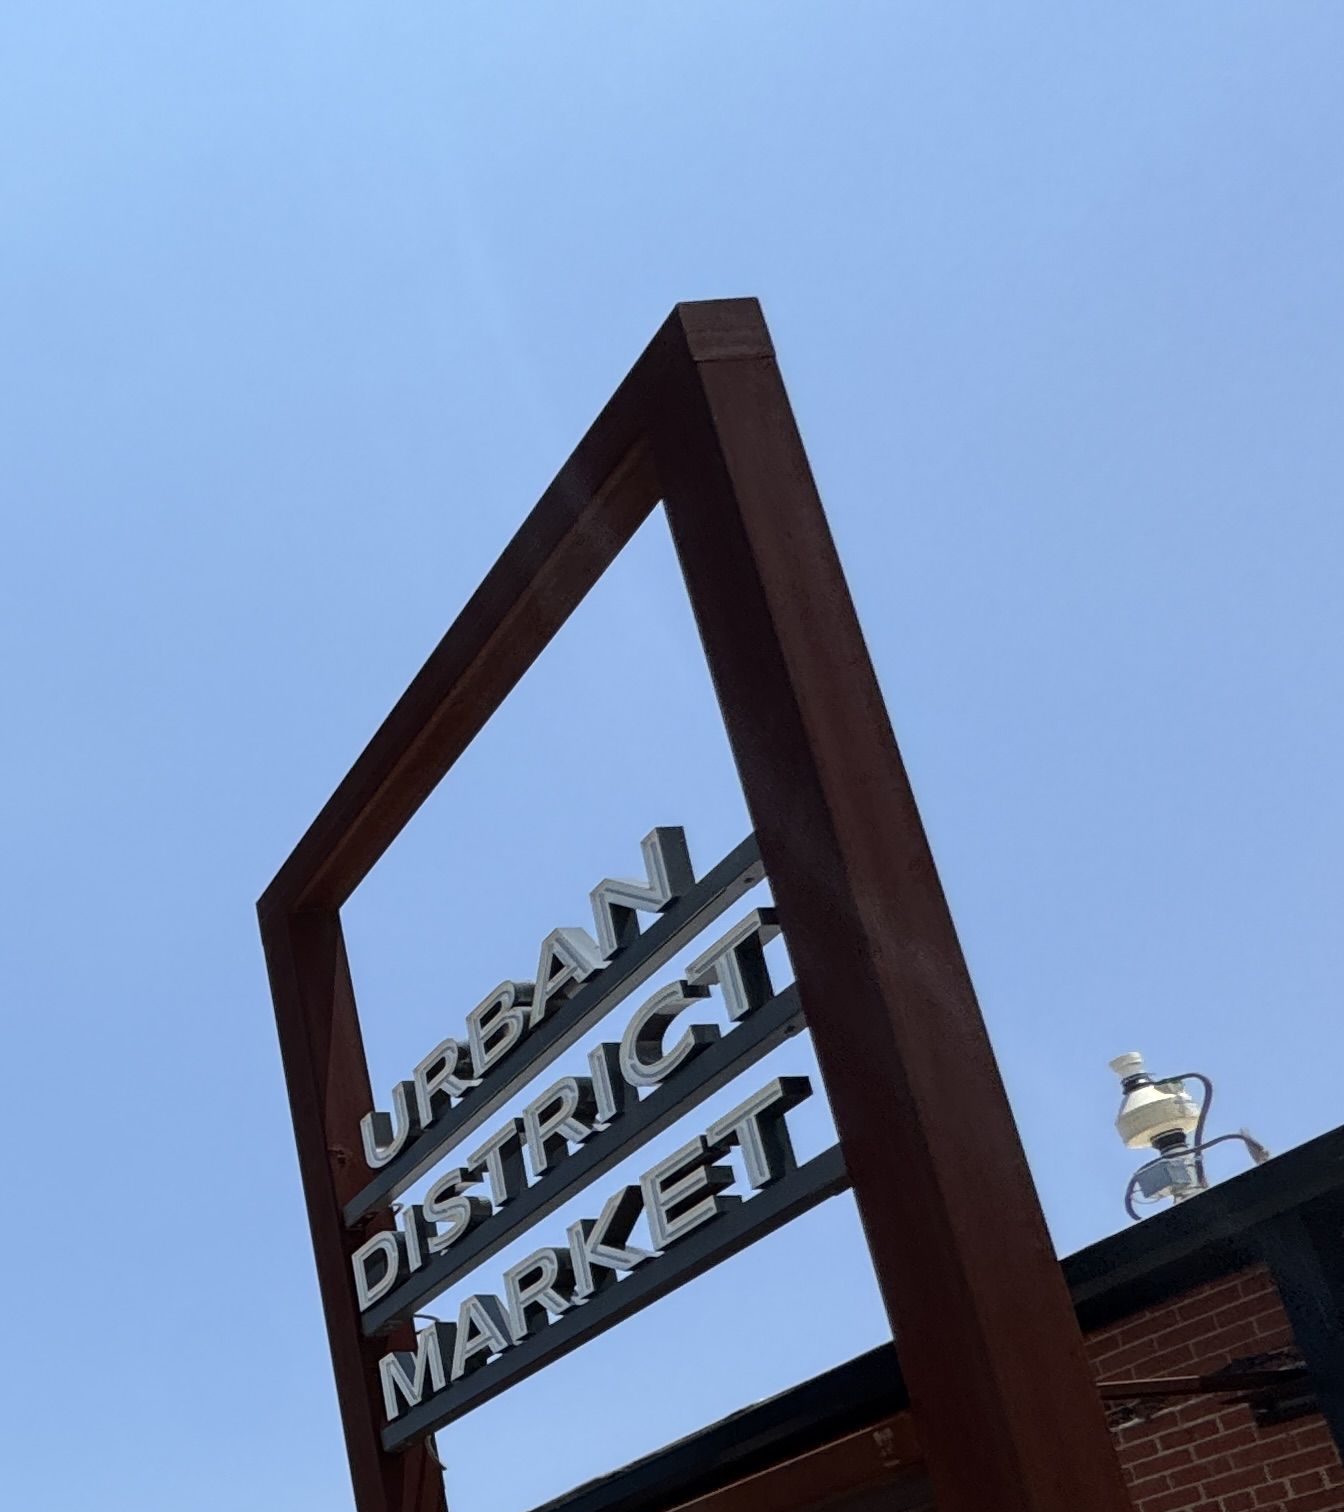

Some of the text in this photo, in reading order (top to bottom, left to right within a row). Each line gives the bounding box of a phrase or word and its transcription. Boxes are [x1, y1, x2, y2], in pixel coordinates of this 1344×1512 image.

[351, 907, 783, 1312] DISTRICT
[360, 826, 696, 1169] URBAN
[378, 1076, 813, 1422] MARKET
